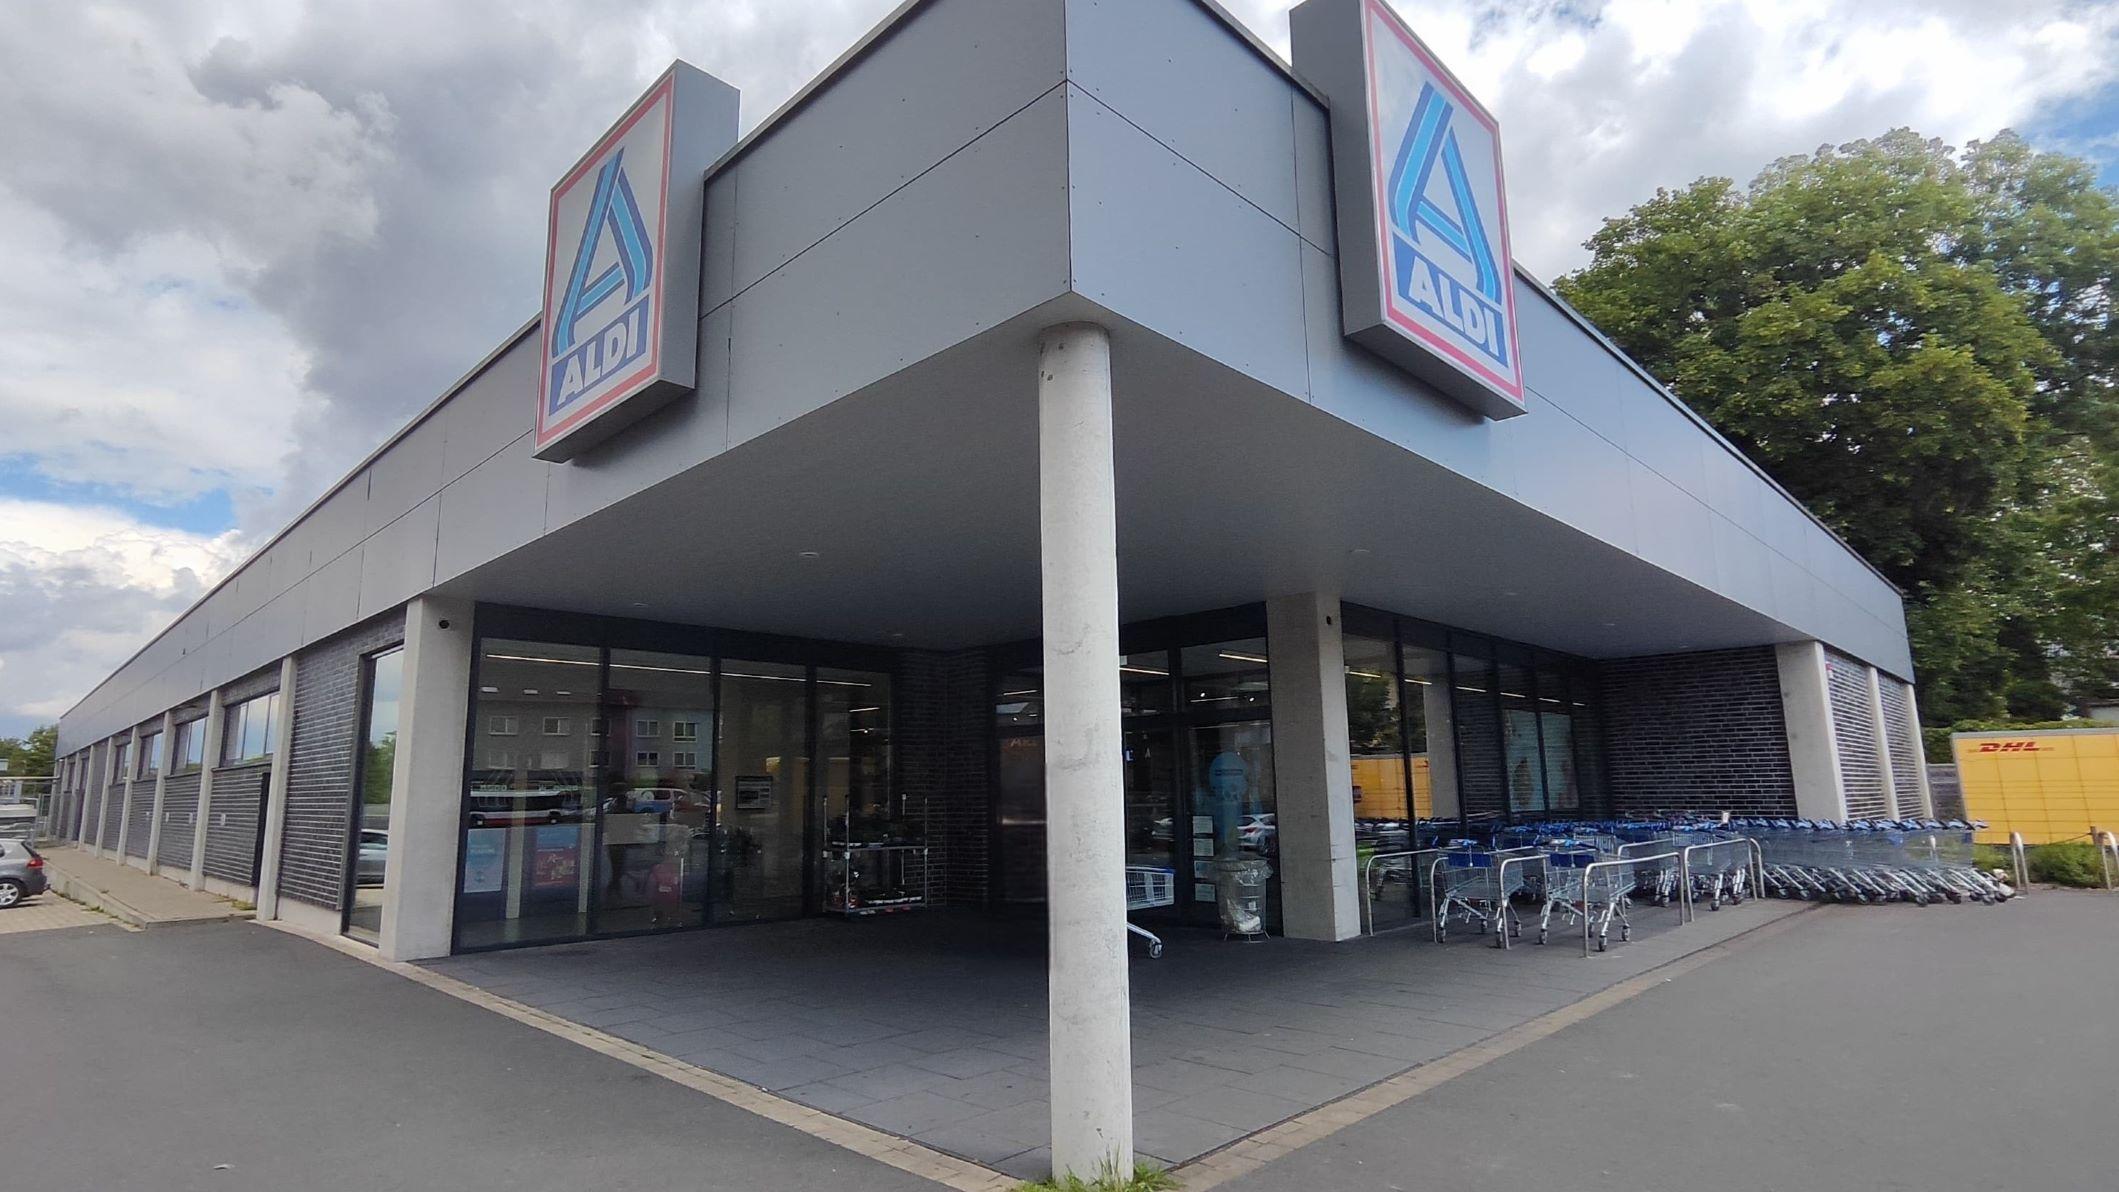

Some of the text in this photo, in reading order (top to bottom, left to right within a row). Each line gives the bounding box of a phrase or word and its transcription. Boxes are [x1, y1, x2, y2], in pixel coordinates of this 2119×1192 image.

[555, 306, 639, 408] ALDI
[1408, 254, 1500, 358] ALDI
[1979, 741, 2041, 753] DHL
